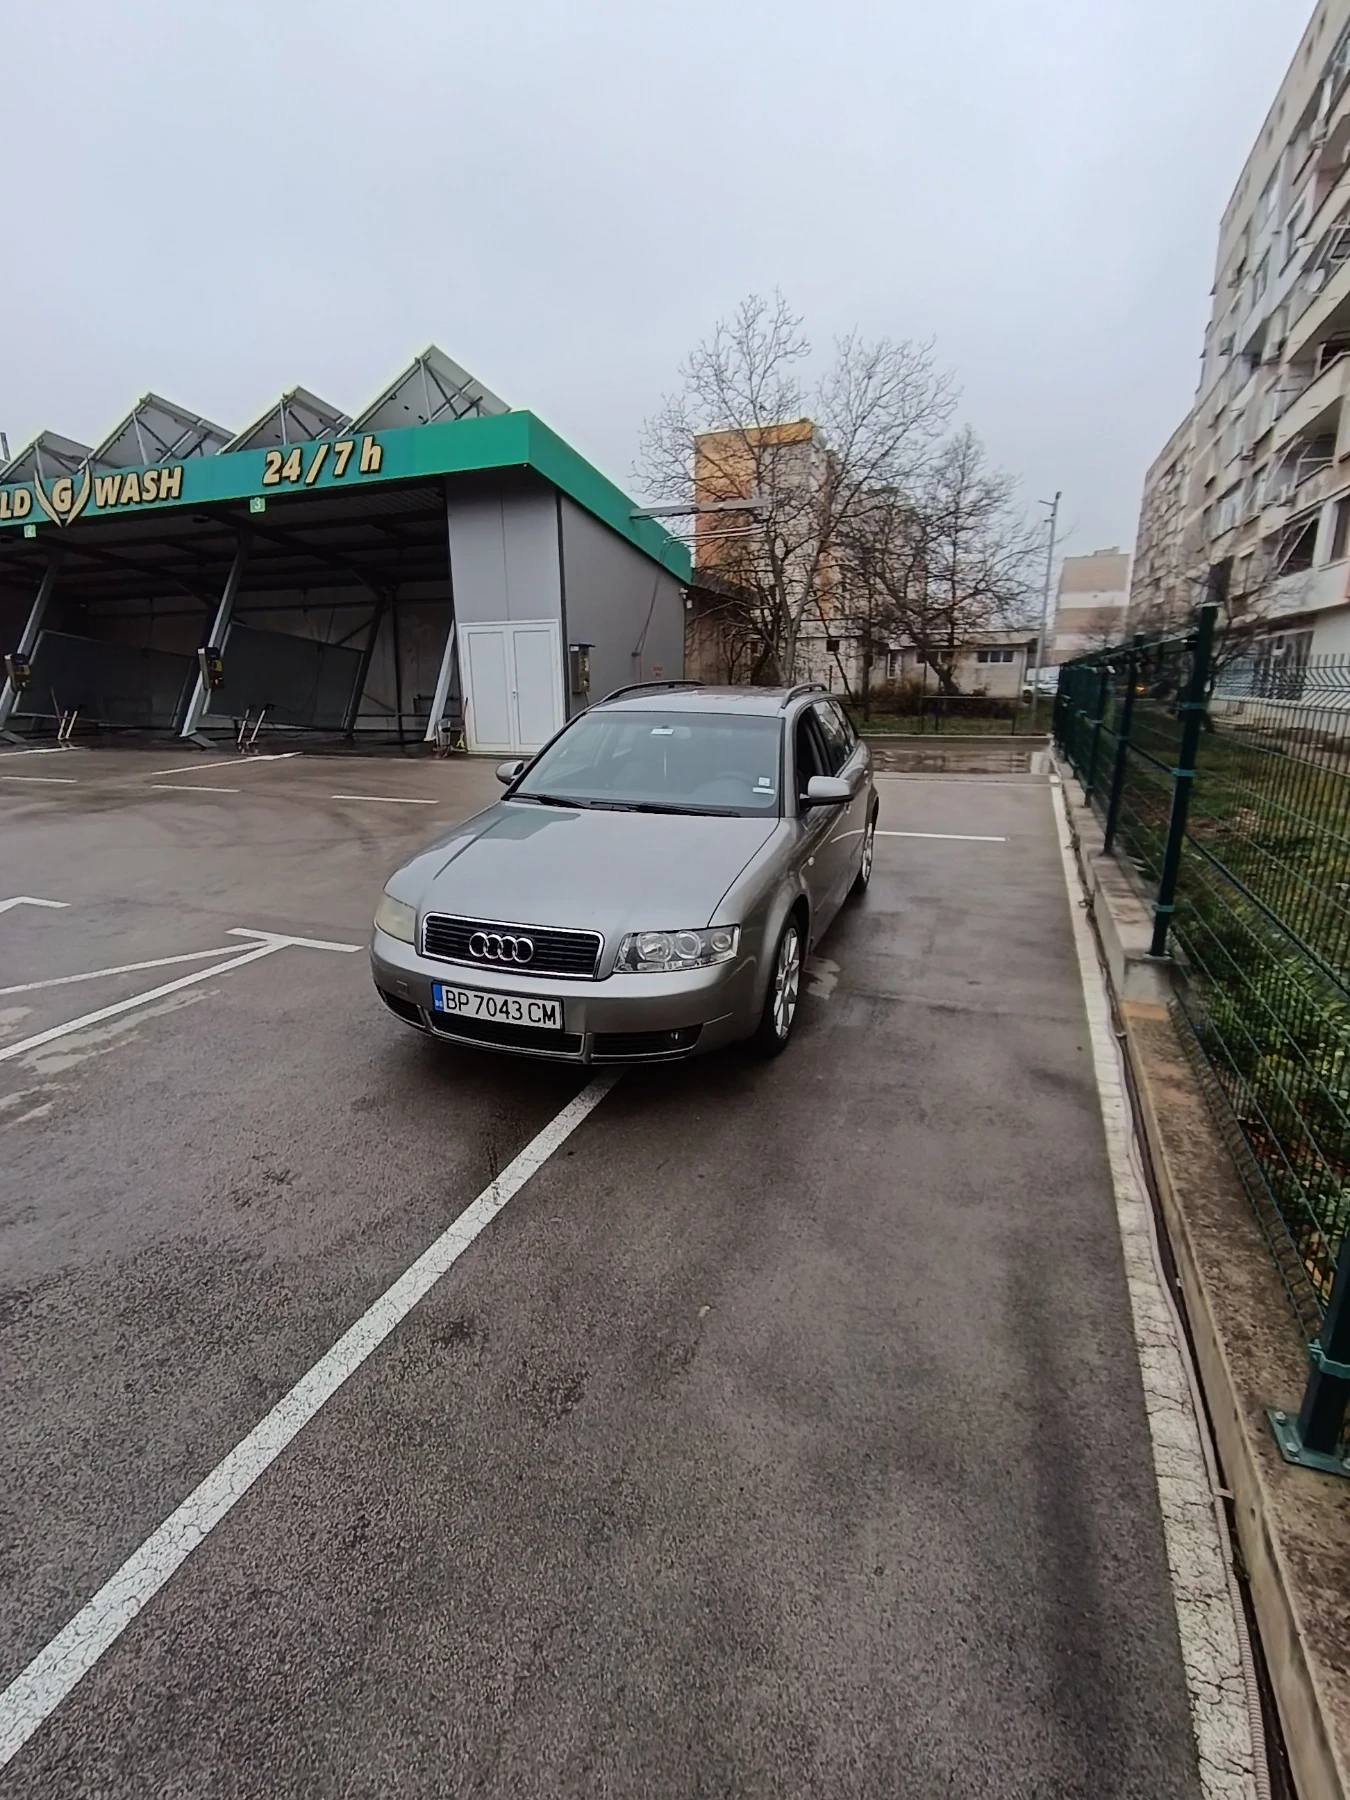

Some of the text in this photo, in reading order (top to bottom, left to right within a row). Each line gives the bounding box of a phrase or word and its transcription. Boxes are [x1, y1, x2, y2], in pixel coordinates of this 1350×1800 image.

[52, 478, 72, 512] G
[95, 466, 183, 507] WASH
[254, 497, 261, 509] 3
